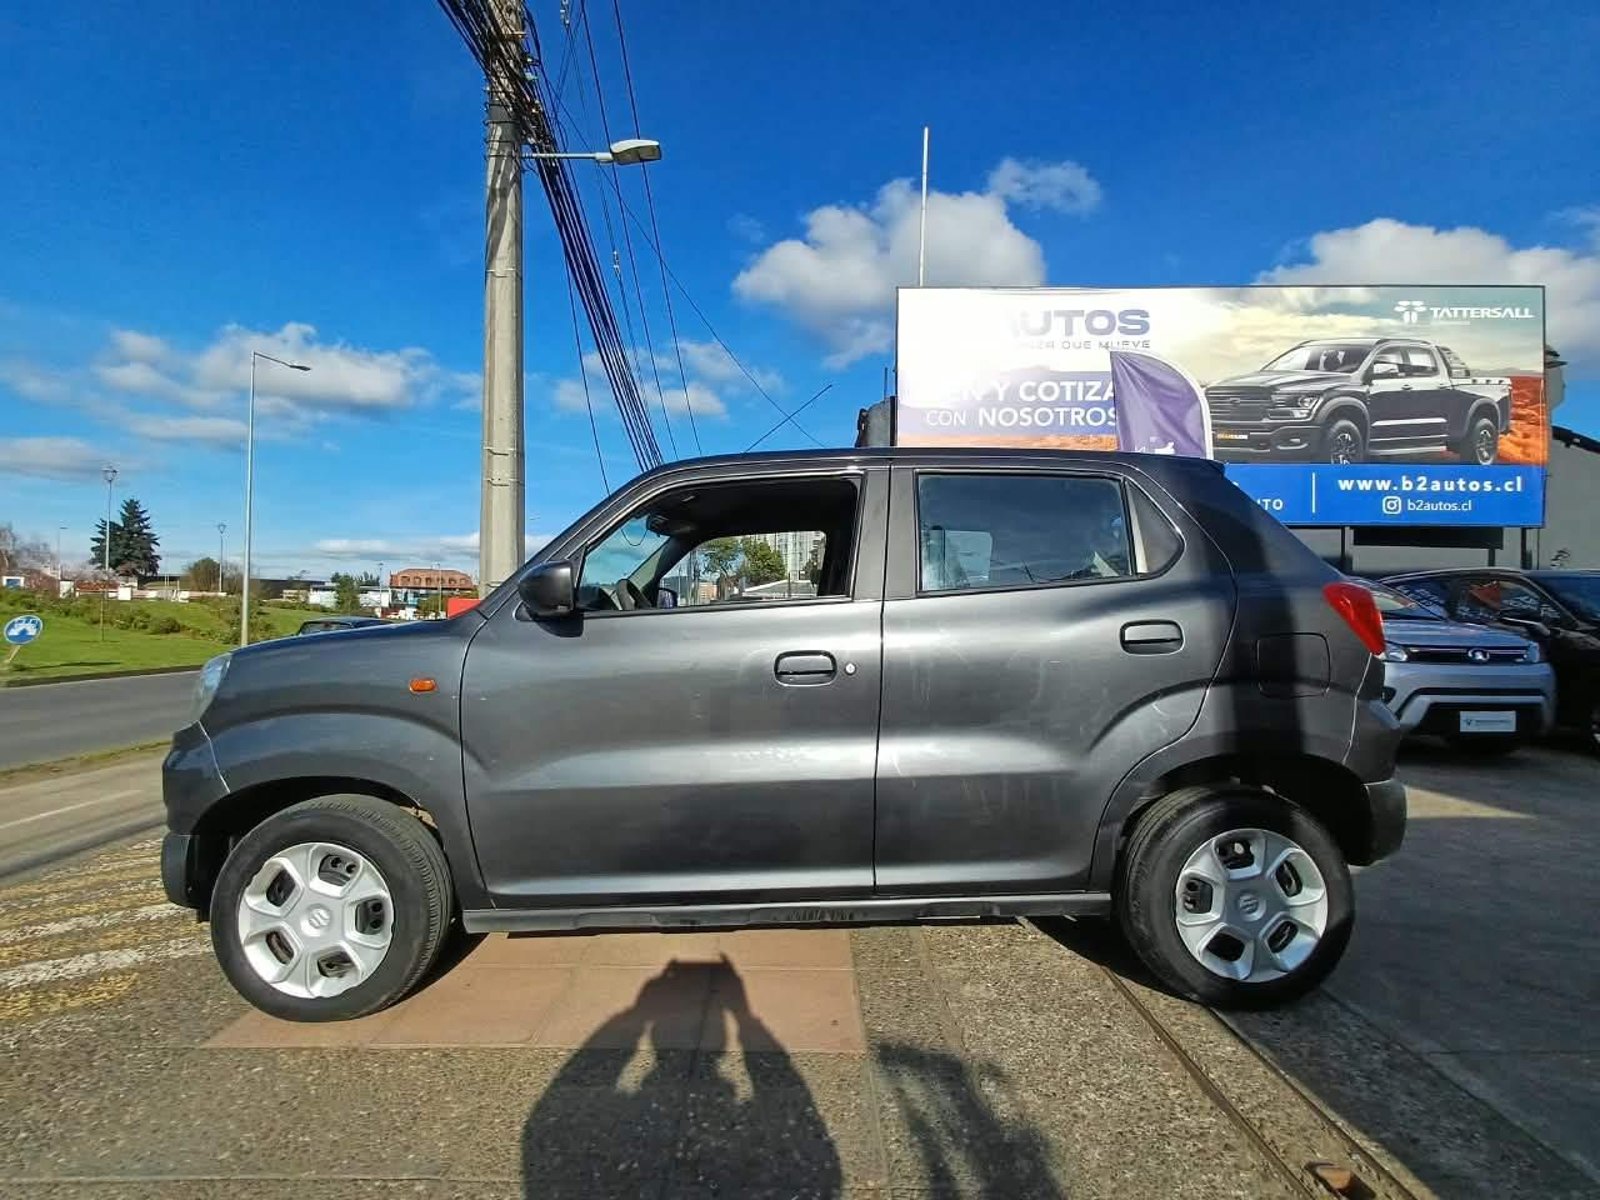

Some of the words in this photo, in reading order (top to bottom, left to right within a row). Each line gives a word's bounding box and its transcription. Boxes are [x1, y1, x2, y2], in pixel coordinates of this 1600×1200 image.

[1429, 306, 1535, 320] TATTERSALL
[1061, 340, 1092, 350] QUE
[926, 409, 967, 427] CON
[1337, 475, 1522, 492] www.b2autos.cl
[1407, 499, 1472, 512] b2autos.cl
